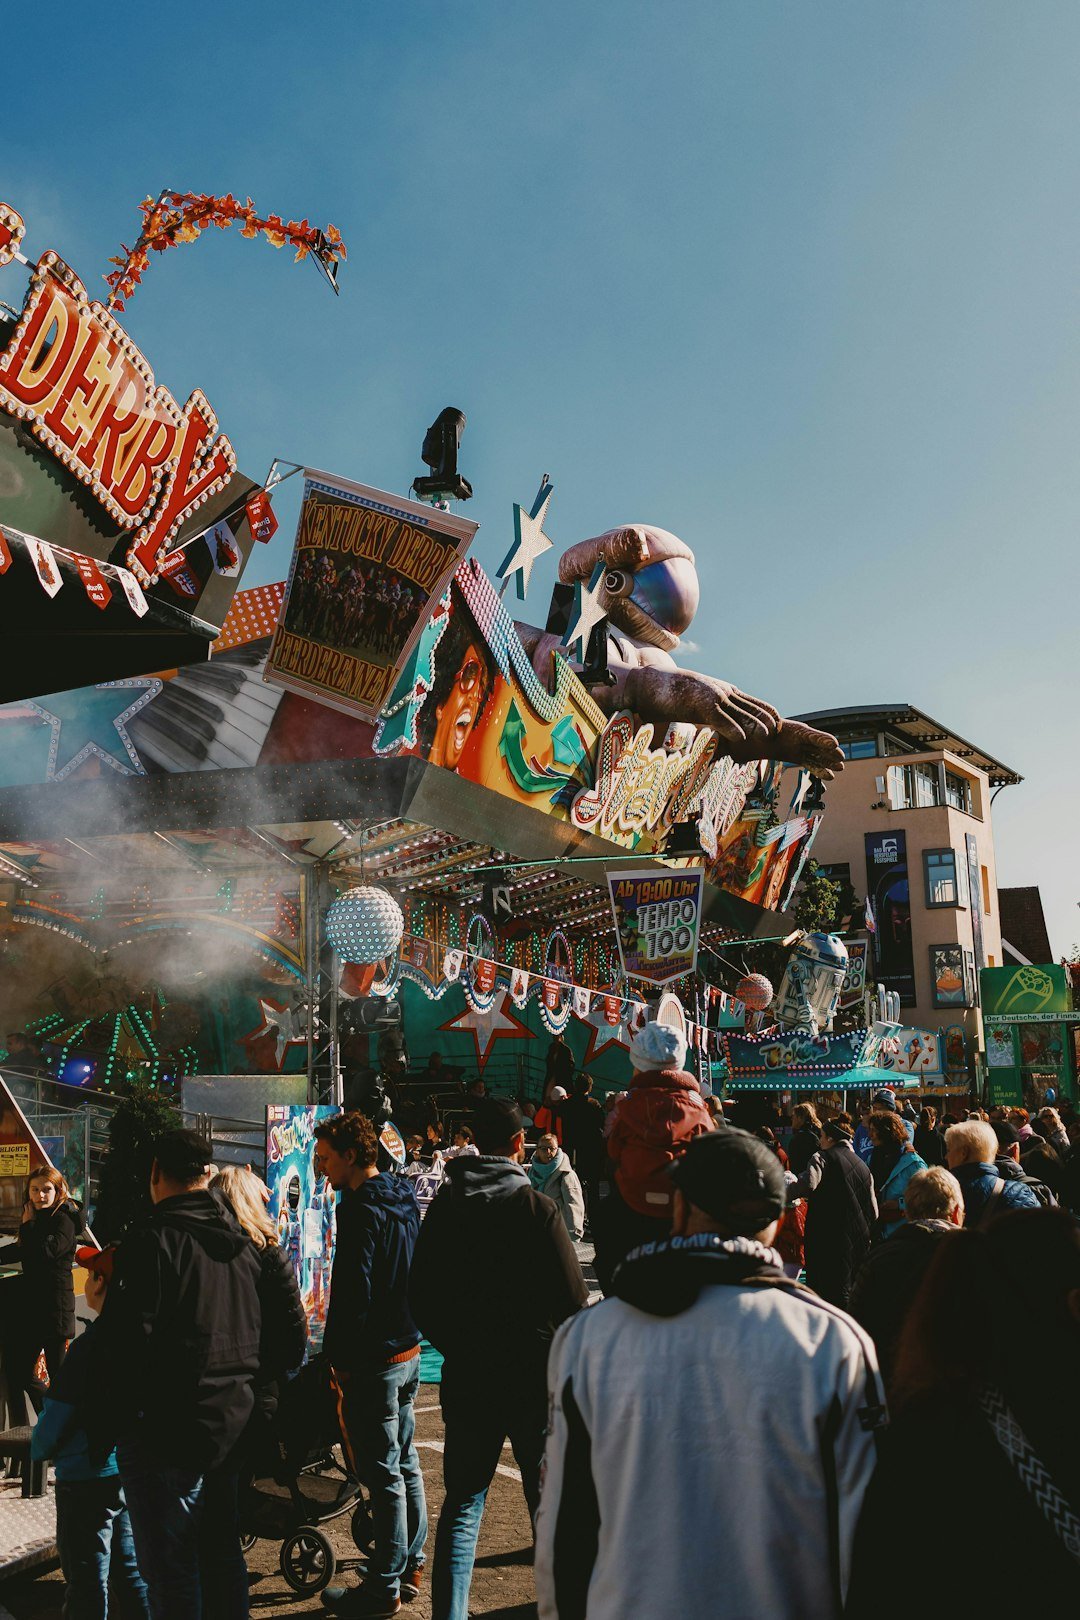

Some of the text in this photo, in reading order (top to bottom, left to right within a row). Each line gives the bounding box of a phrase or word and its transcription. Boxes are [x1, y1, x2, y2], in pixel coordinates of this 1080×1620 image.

[0, 268, 228, 576] DERBY
[297, 498, 462, 596] KENTUCKY DERBY
[269, 624, 402, 701] PFERDERENNEN
[615, 879, 698, 904] Ab 19:00 Uhr
[637, 899, 696, 934] TEMPO
[645, 925, 693, 960] 100
[1056, 1012, 1080, 1020] Finne,
